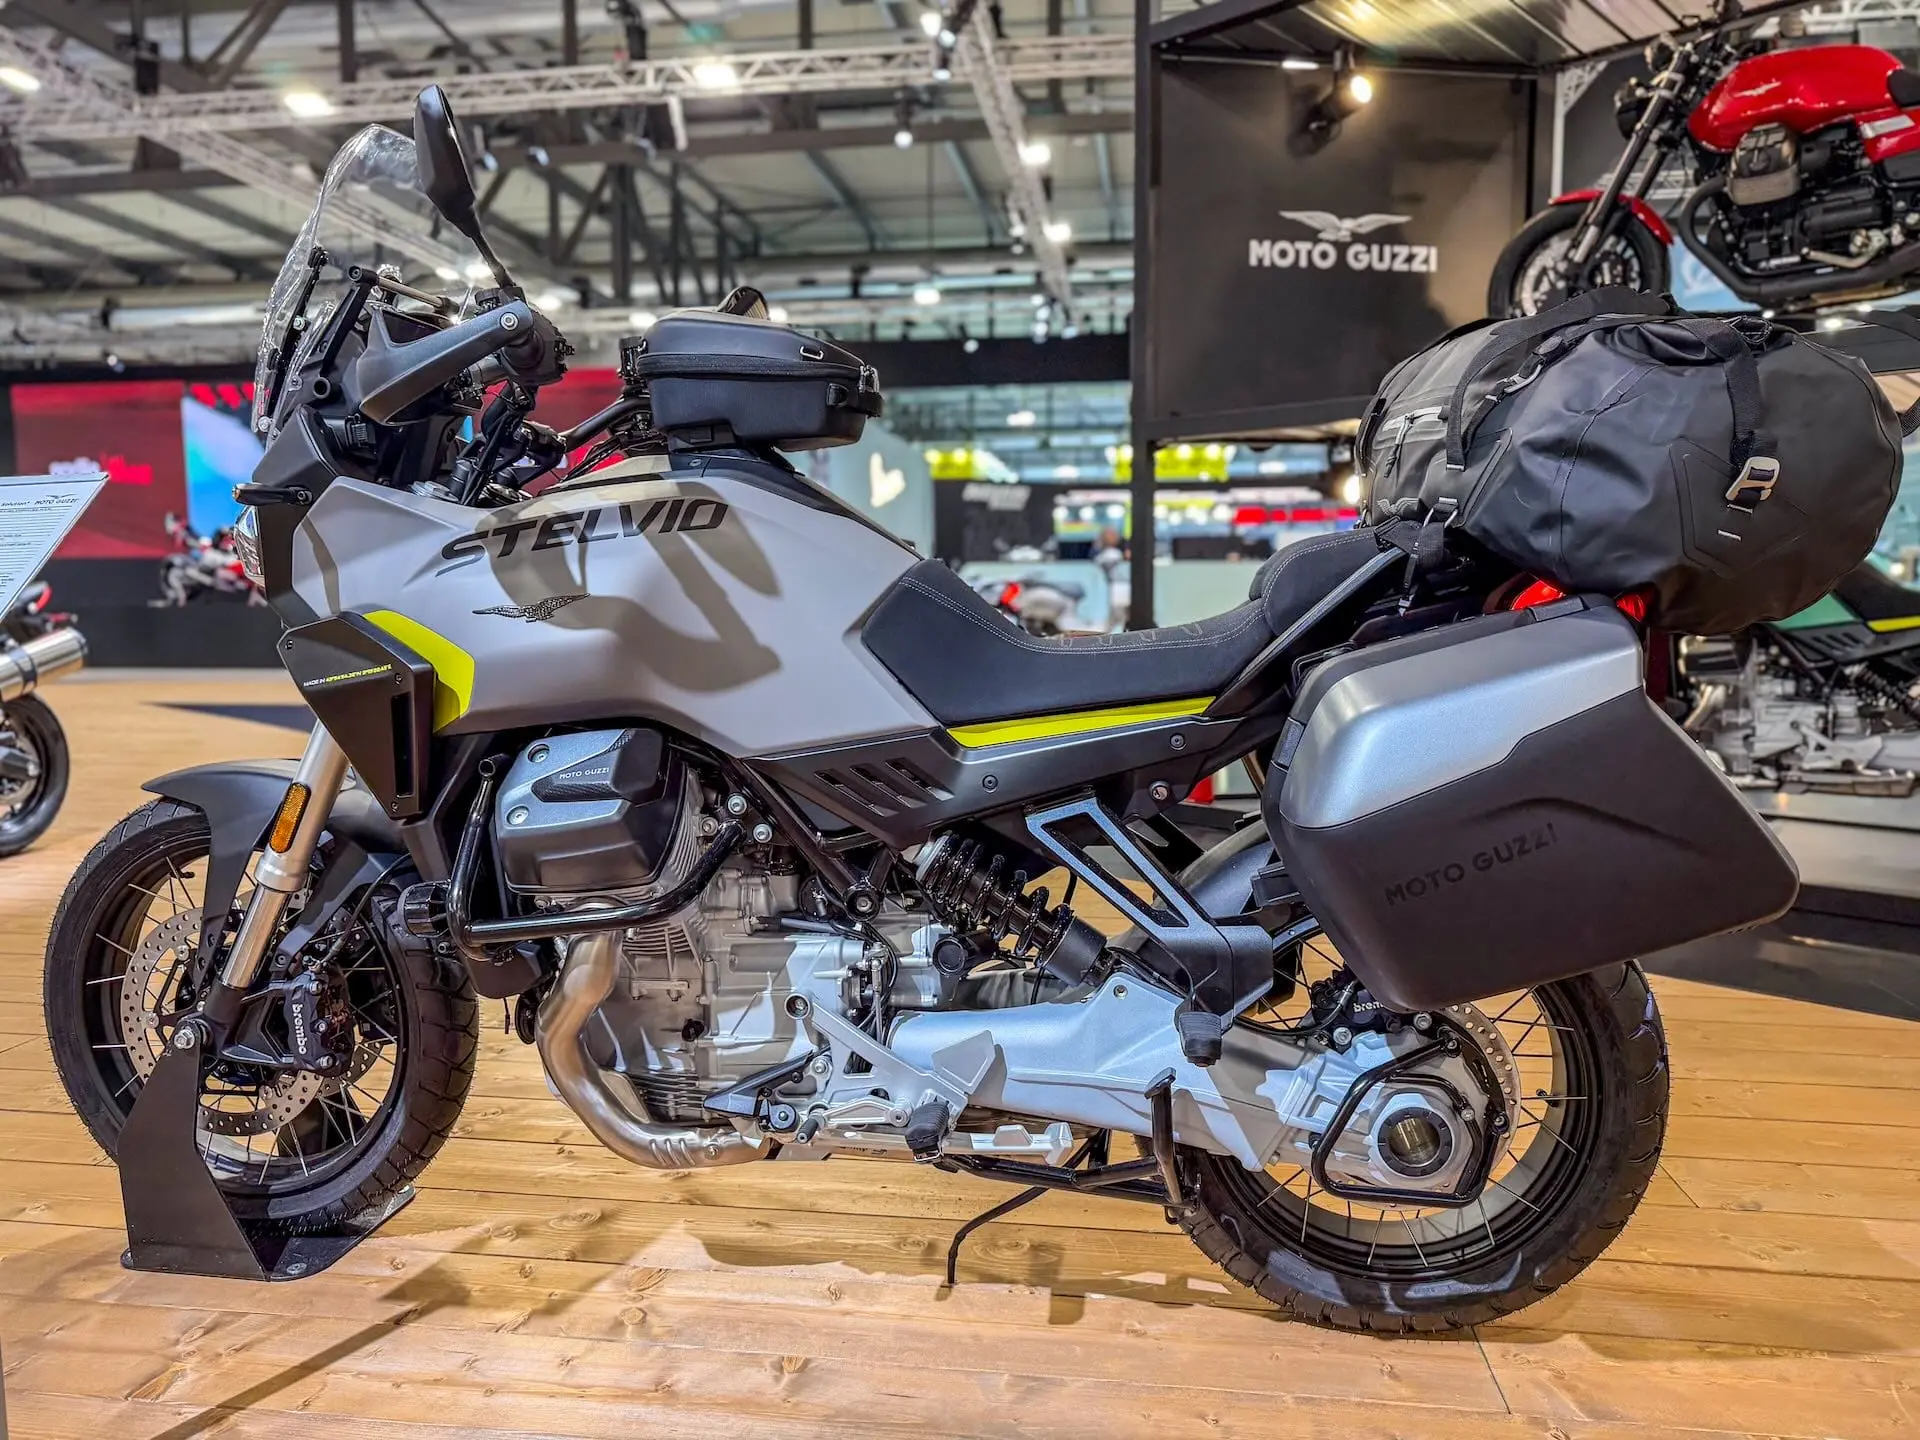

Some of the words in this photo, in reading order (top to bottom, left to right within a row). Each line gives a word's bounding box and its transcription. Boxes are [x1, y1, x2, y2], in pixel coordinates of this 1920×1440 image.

[1248, 239, 1337, 270] MOTO
[1346, 243, 1438, 273] GUZZI
[435, 499, 729, 577] STELVIO
[559, 770, 582, 780] MOTO
[584, 766, 610, 776] GUZZI
[1384, 863, 1465, 906] MOTO
[1472, 822, 1559, 872] GUZZI
[292, 1003, 308, 1055] brembo
